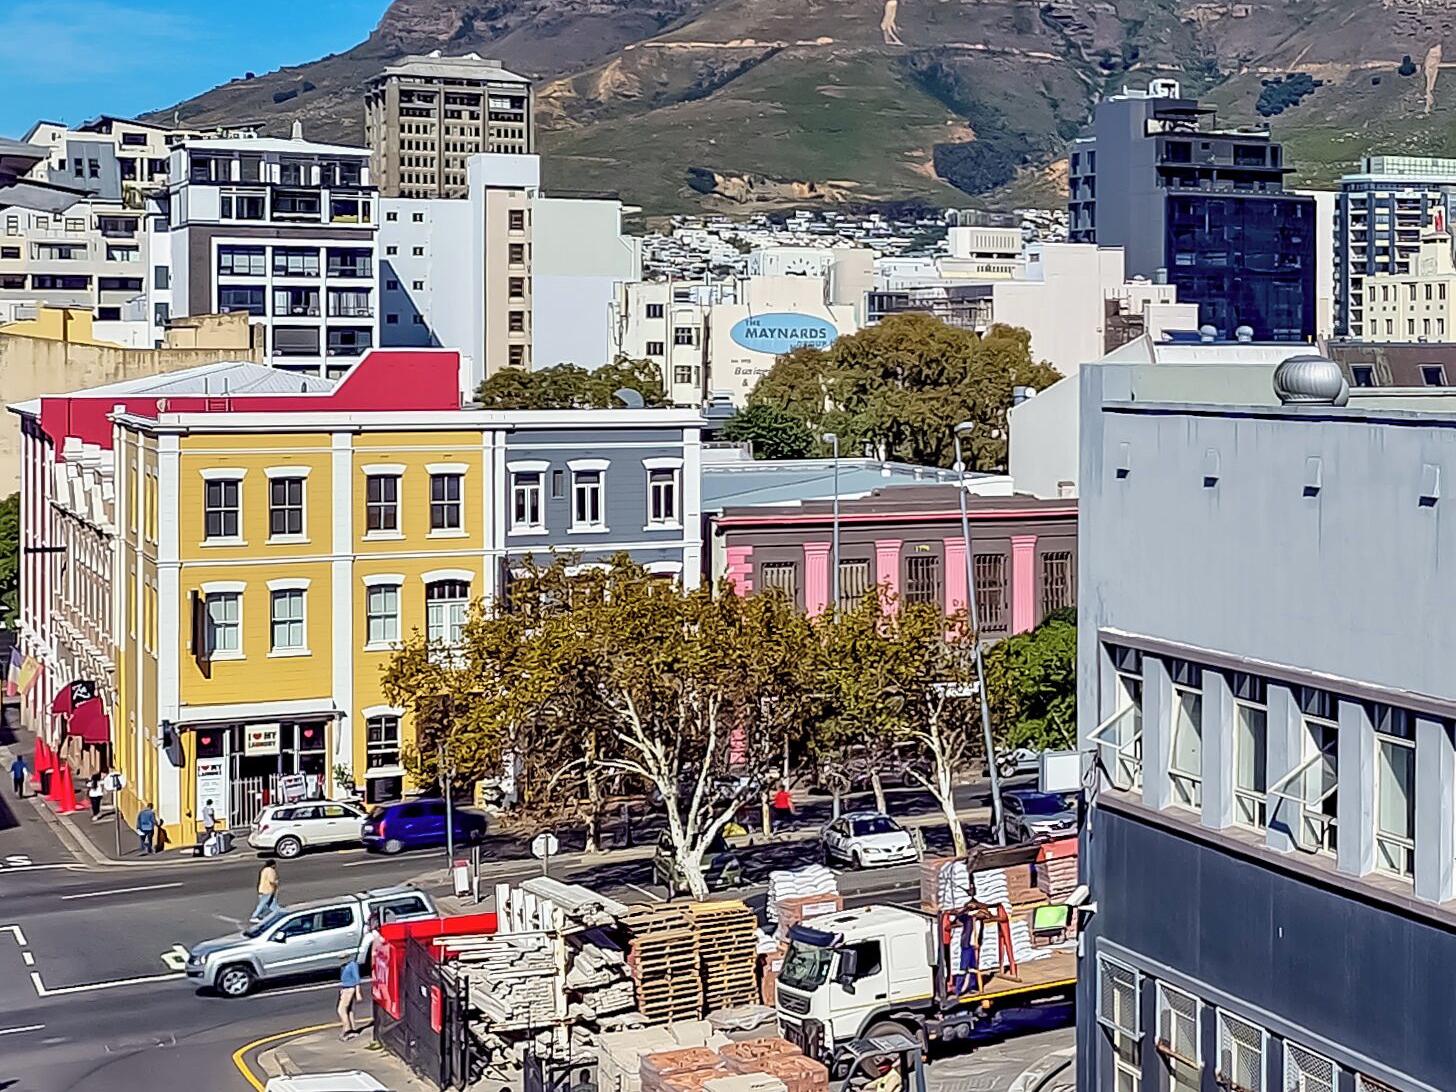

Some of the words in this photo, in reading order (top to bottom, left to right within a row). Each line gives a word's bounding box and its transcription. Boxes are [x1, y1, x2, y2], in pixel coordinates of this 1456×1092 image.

[745, 319, 761, 327] THE
[745, 328, 827, 339] MAYNARDS
[263, 731, 276, 740] MY
